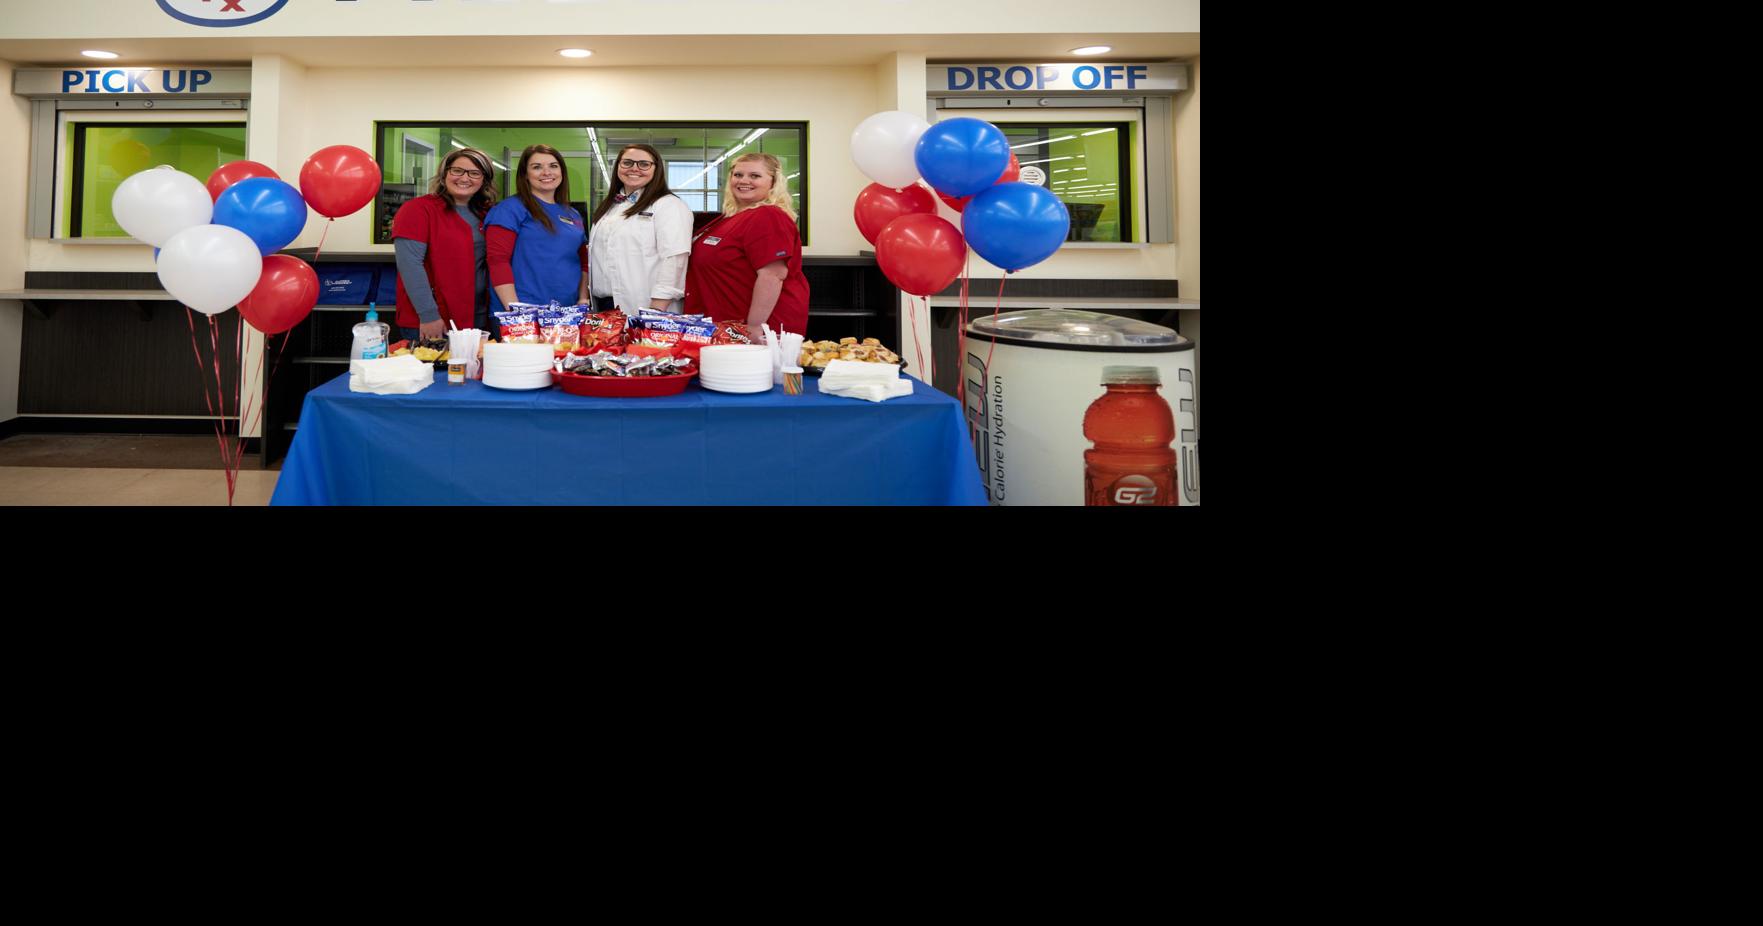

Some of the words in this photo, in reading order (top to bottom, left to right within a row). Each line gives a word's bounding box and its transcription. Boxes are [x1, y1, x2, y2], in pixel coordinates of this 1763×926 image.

[62, 69, 151, 93] PICK
[162, 69, 212, 93] UP
[947, 66, 1059, 91] DROP
[1072, 65, 1148, 90] OFF
[992, 375, 1007, 448] Hydration
[994, 450, 1006, 501] Calorie
[1114, 486, 1157, 504] G2
